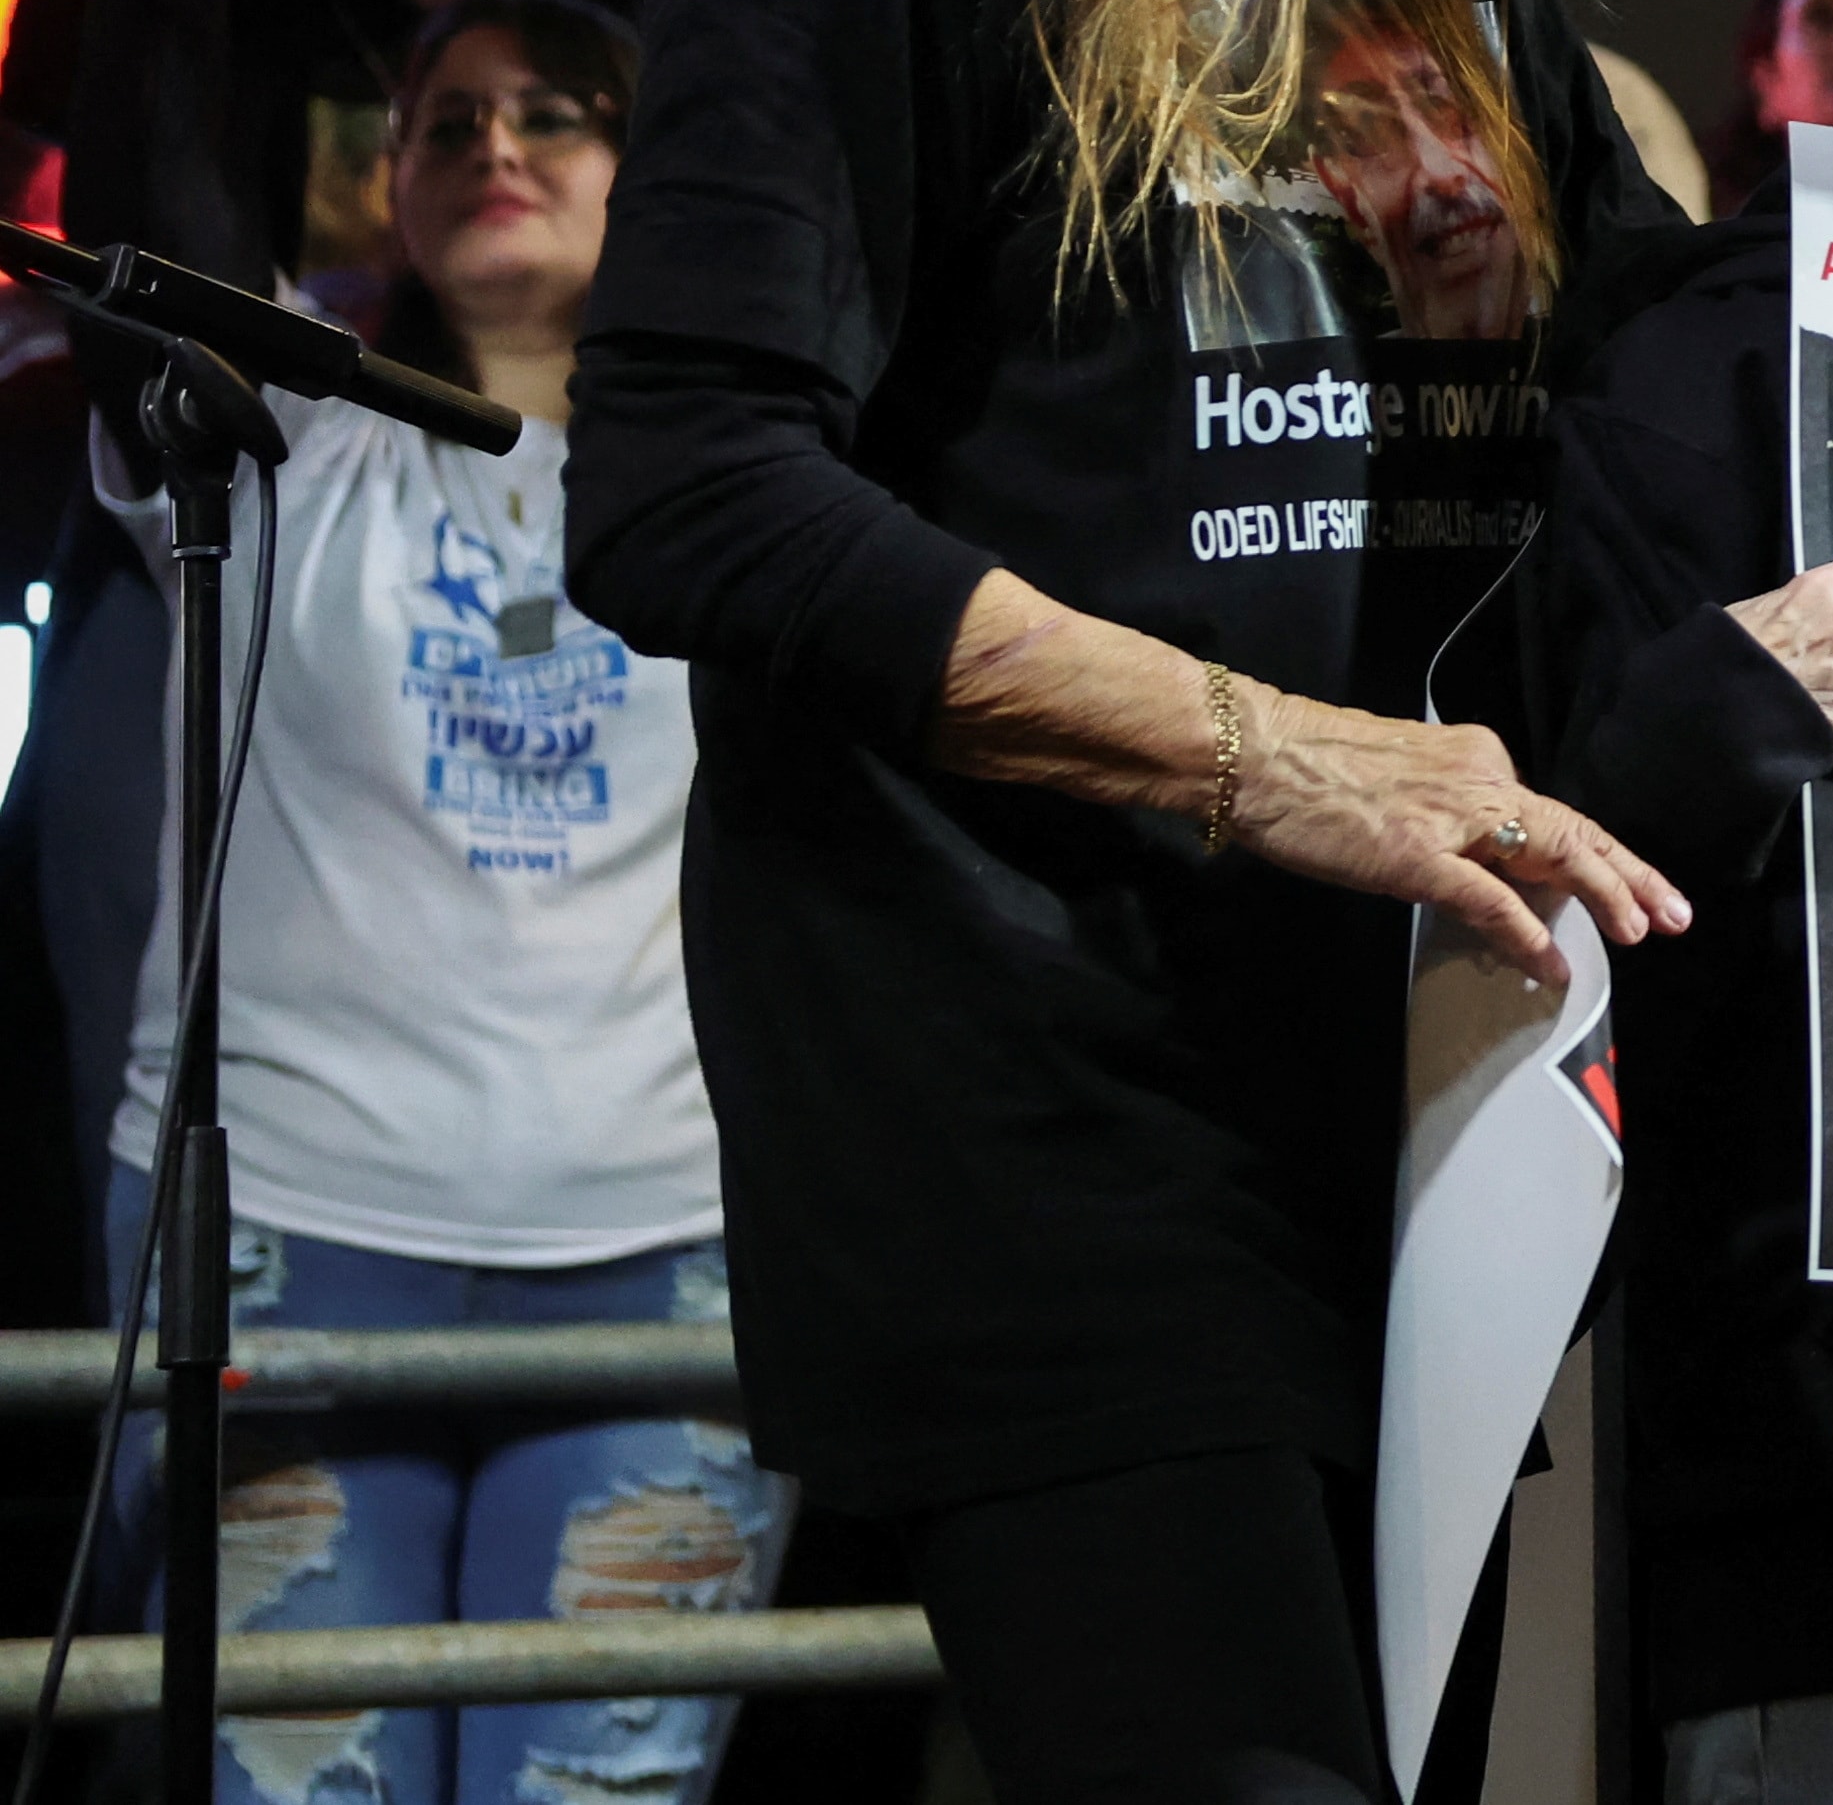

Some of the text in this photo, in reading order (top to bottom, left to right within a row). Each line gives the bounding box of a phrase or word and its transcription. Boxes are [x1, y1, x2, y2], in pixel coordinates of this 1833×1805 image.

[1194, 368, 1405, 454] Hostage
[1417, 384, 1500, 438] now
[1191, 504, 1281, 561] ODED
